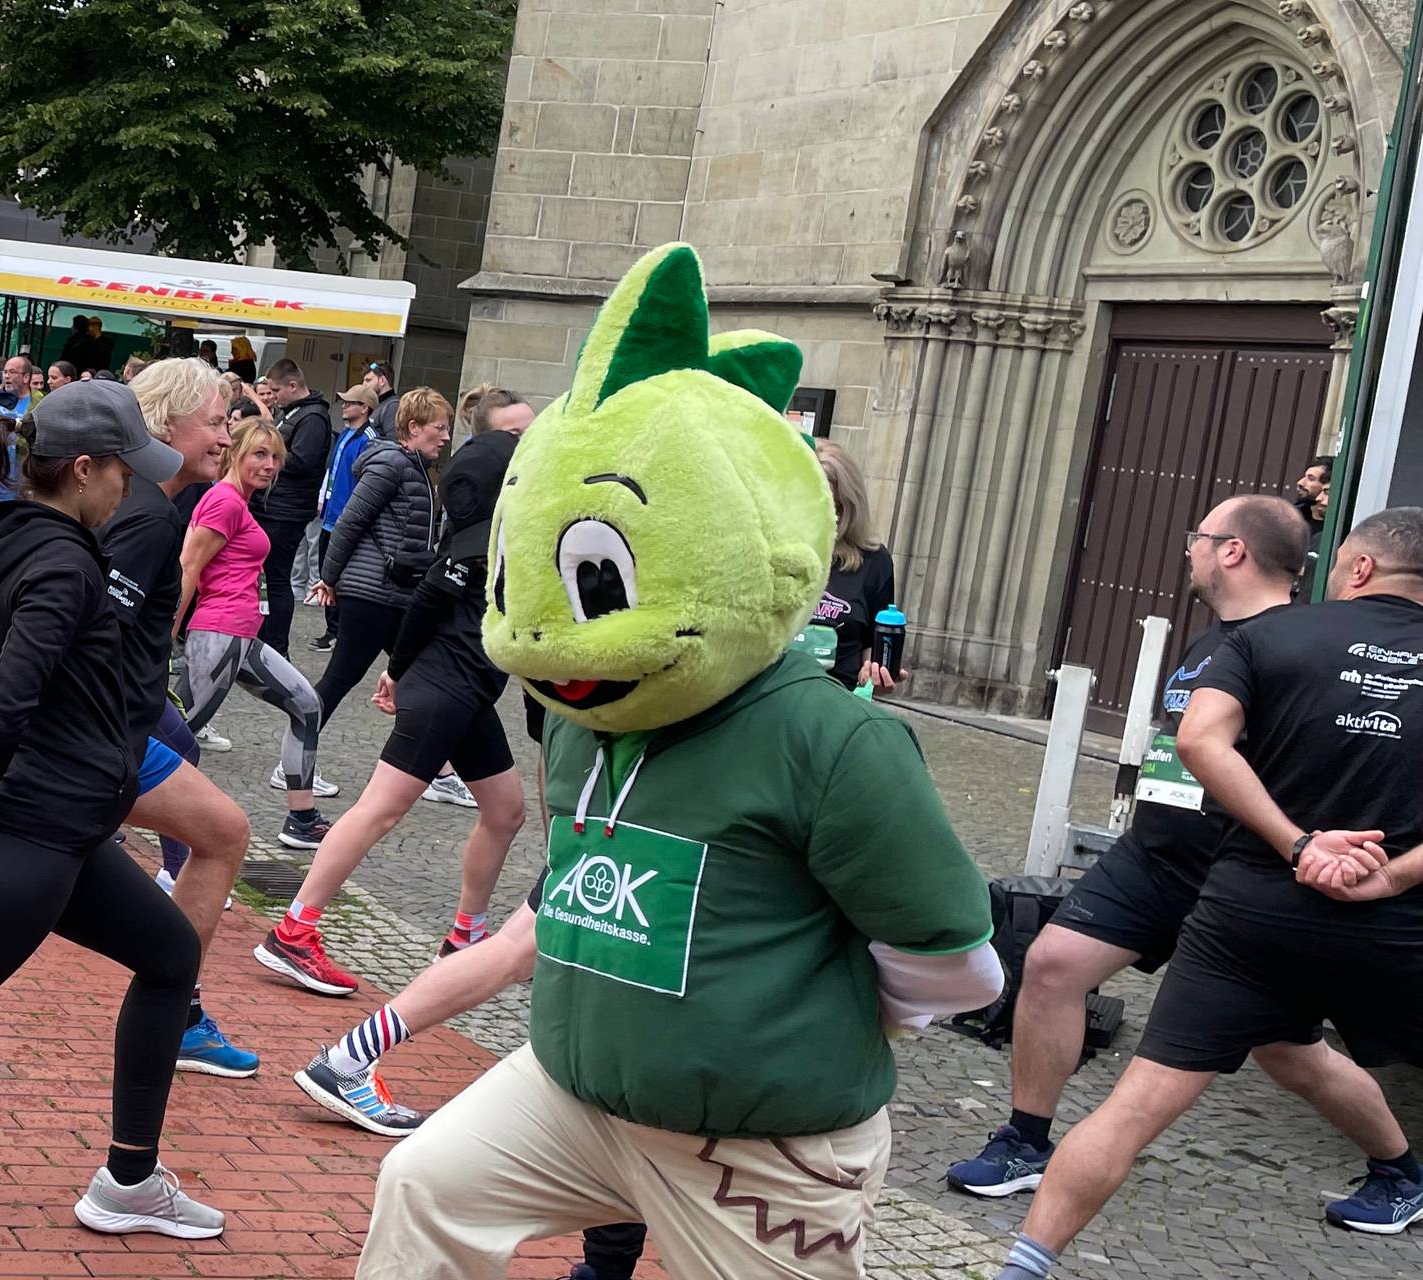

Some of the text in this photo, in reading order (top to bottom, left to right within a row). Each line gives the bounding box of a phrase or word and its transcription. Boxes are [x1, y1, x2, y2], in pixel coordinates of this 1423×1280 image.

[56, 276, 307, 311] ISENBECK
[1366, 652, 1418, 665] MOBILE
[548, 853, 659, 928] AOK
[555, 906, 652, 946] Gesundheitskasse.
